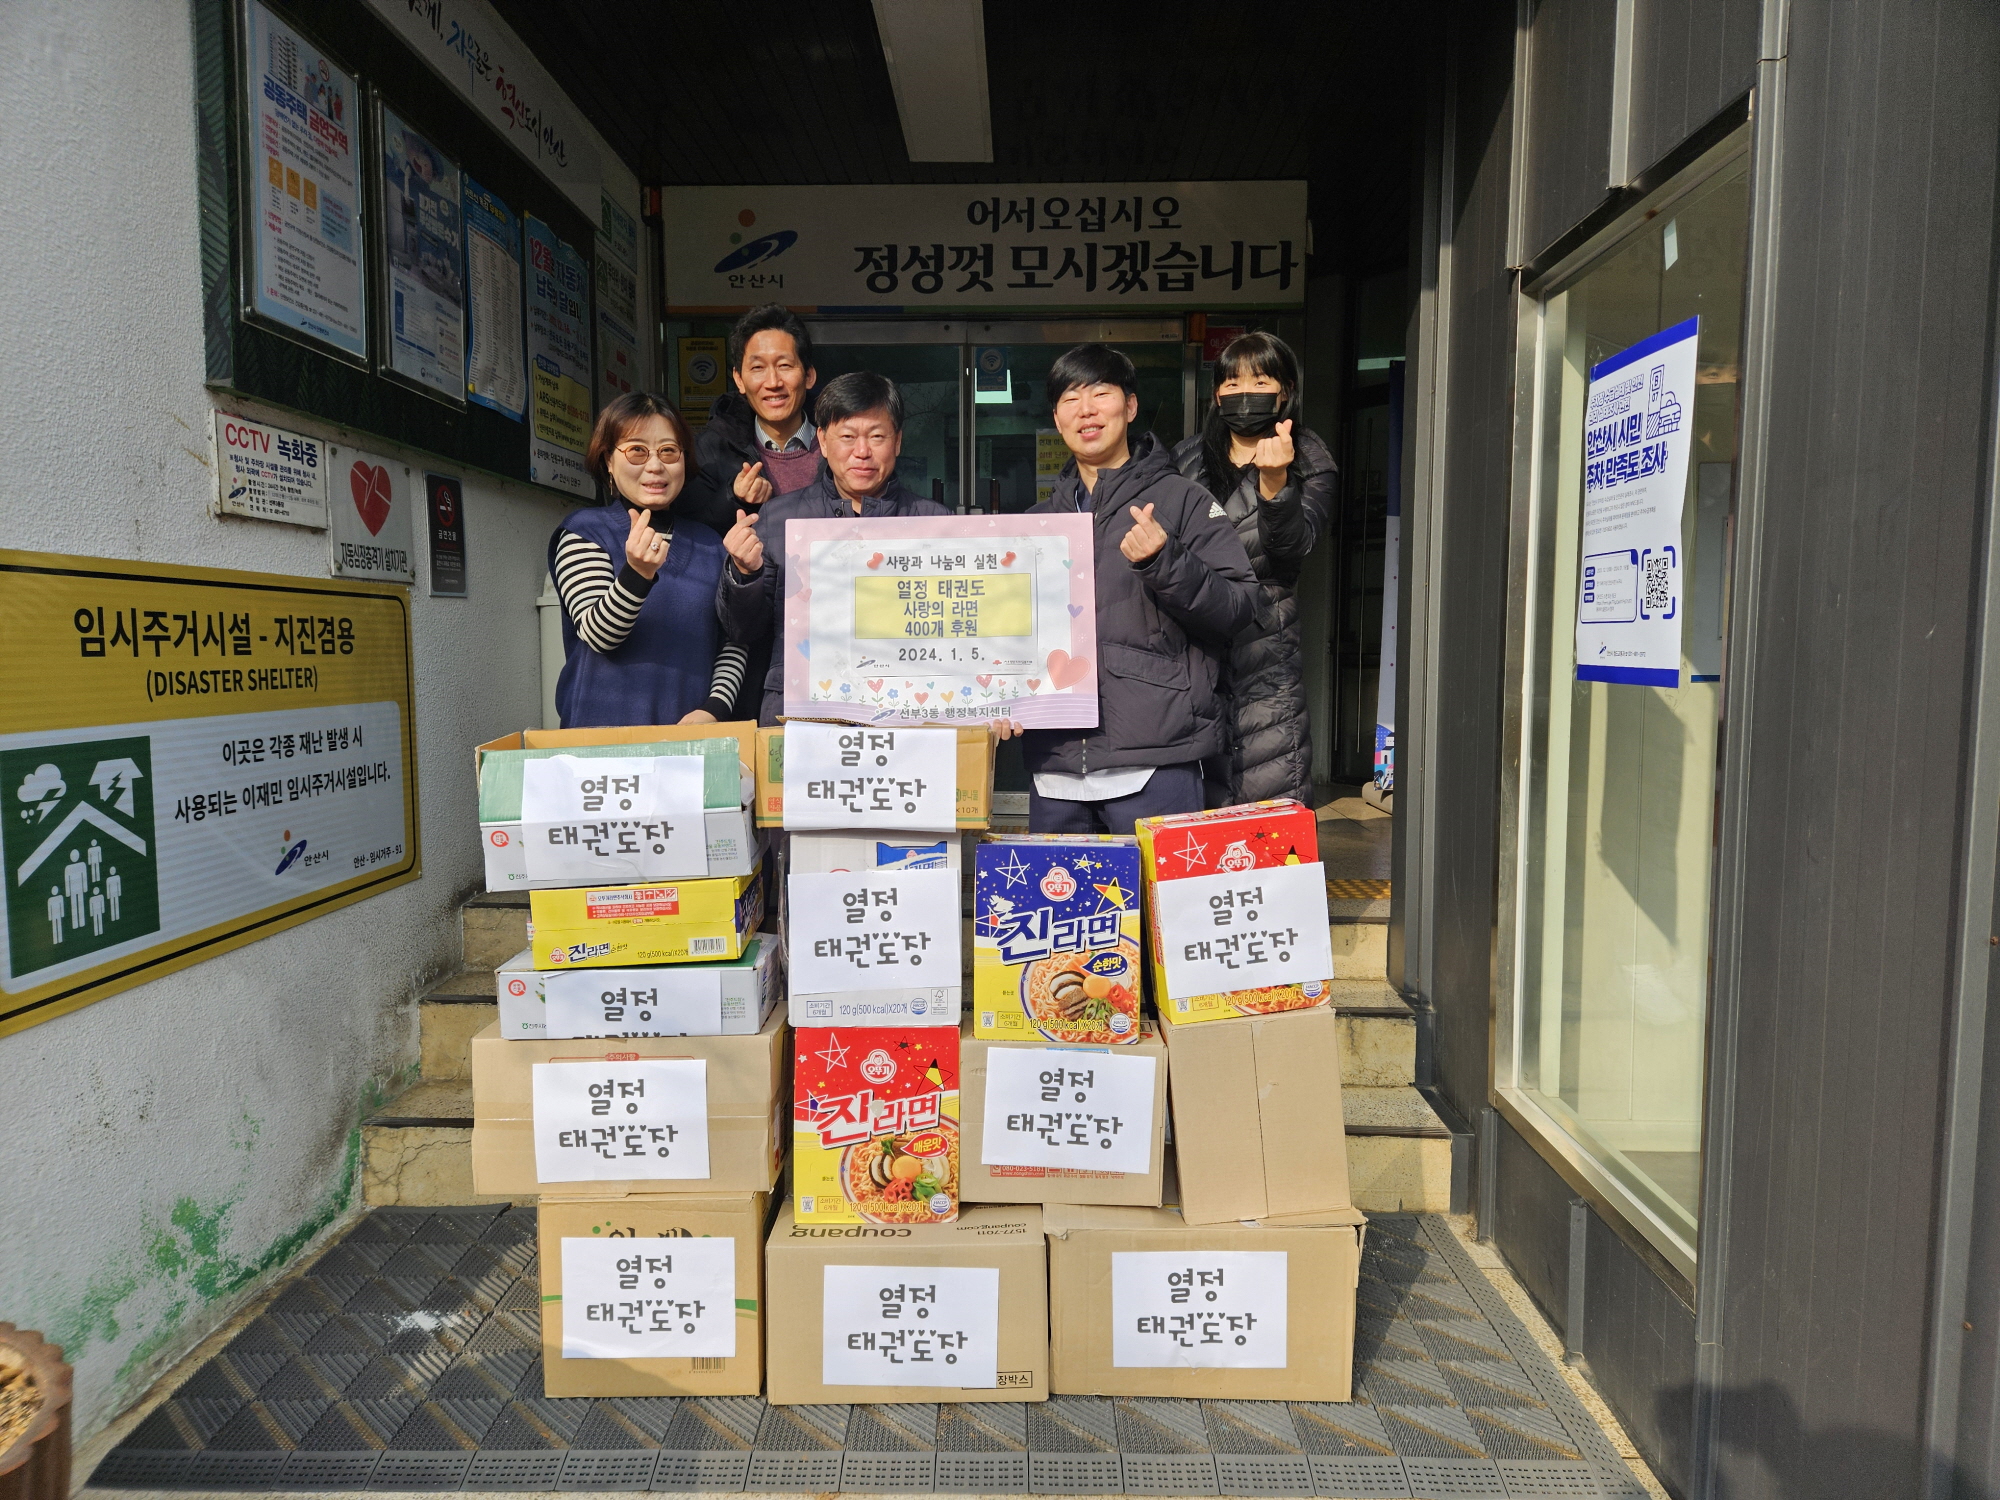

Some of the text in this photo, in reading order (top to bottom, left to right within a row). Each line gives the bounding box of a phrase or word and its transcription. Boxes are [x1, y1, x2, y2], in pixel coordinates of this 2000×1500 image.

[263, 74, 308, 126] 공동주택
[309, 108, 349, 161] 금연구역
[966, 197, 1182, 232] 어서오십시오
[728, 273, 784, 289] 안산시
[854, 240, 1300, 293] 정성껏 모시겠습니다
[225, 423, 318, 468] CCTV 녹화중
[1587, 412, 1643, 460] 안산시 시민
[235, 465, 245, 474] 청사
[260, 470, 277, 480] CCTV가
[278, 474, 295, 484] 설치되어
[244, 457, 249, 465] 및
[250, 458, 264, 468] 주차장
[301, 470, 310, 478] 청사
[1587, 441, 1668, 492] 주차 만족도 조사
[231, 500, 245, 508] 안산시
[340, 543, 384, 571] 자동심장충격기
[385, 549, 408, 573] 설치기관
[886, 553, 997, 572] 사랑과 나눔의 실천
[897, 578, 986, 600] 열정 태권도
[904, 600, 979, 618] 사랑의 라면
[74, 606, 251, 658] 임시주거시설
[275, 615, 355, 656] 지진겸용
[905, 618, 978, 639] 400개 후원
[898, 646, 985, 661] 2024. 1. 5.
[146, 666, 319, 703] (DISASTER SHELTER)
[899, 704, 1012, 719] 선부3동 행정복지센터
[223, 725, 364, 768] 이곳은 각종 재난 발생 시
[838, 731, 895, 766] 열정
[175, 761, 392, 824] 사용되는 이재민 임시주거시설입니다.
[581, 775, 640, 812] 열정
[807, 777, 927, 814] 태권도장
[962, 789, 979, 801] 콩나물
[548, 821, 675, 857] 태권도장
[303, 850, 330, 866] 안산시
[353, 855, 367, 869] 안산
[1226, 856, 1250, 869] 오뚜기
[1046, 882, 1070, 894] 오뚜기
[843, 888, 898, 924] 열정
[1209, 886, 1264, 926] 열정
[569, 942, 611, 964] 진라면
[815, 932, 932, 969] 태권도장
[996, 907, 1121, 966] 진라면
[1184, 928, 1299, 970] 태권도장
[637, 950, 646, 959] 120
[1092, 957, 1122, 973] 순한맛
[601, 987, 658, 1022] 열정
[840, 1001, 908, 1017] 120 g(500 kcal)X20개
[1224, 995, 1236, 1006] 120
[1030, 1018, 1042, 1029] 120
[867, 1065, 891, 1076] 오뚜기
[1039, 1067, 1093, 1104] 열정
[588, 1079, 645, 1116] 열정
[816, 1090, 941, 1150] 진라면
[1006, 1113, 1124, 1150] 태권도장
[559, 1124, 679, 1159] 태권도장
[913, 1136, 943, 1154] 매운맛
[850, 1201, 862, 1213] 120
[788, 1225, 912, 1238] coupang
[957, 1222, 1027, 1231] coupang.com
[616, 1255, 673, 1290] 열정
[1167, 1268, 1223, 1303] 열정
[586, 1300, 706, 1335] 태권도장
[879, 1284, 936, 1319] 열정
[848, 1329, 969, 1365] 태권도장
[1137, 1313, 1257, 1347] 태권도장
